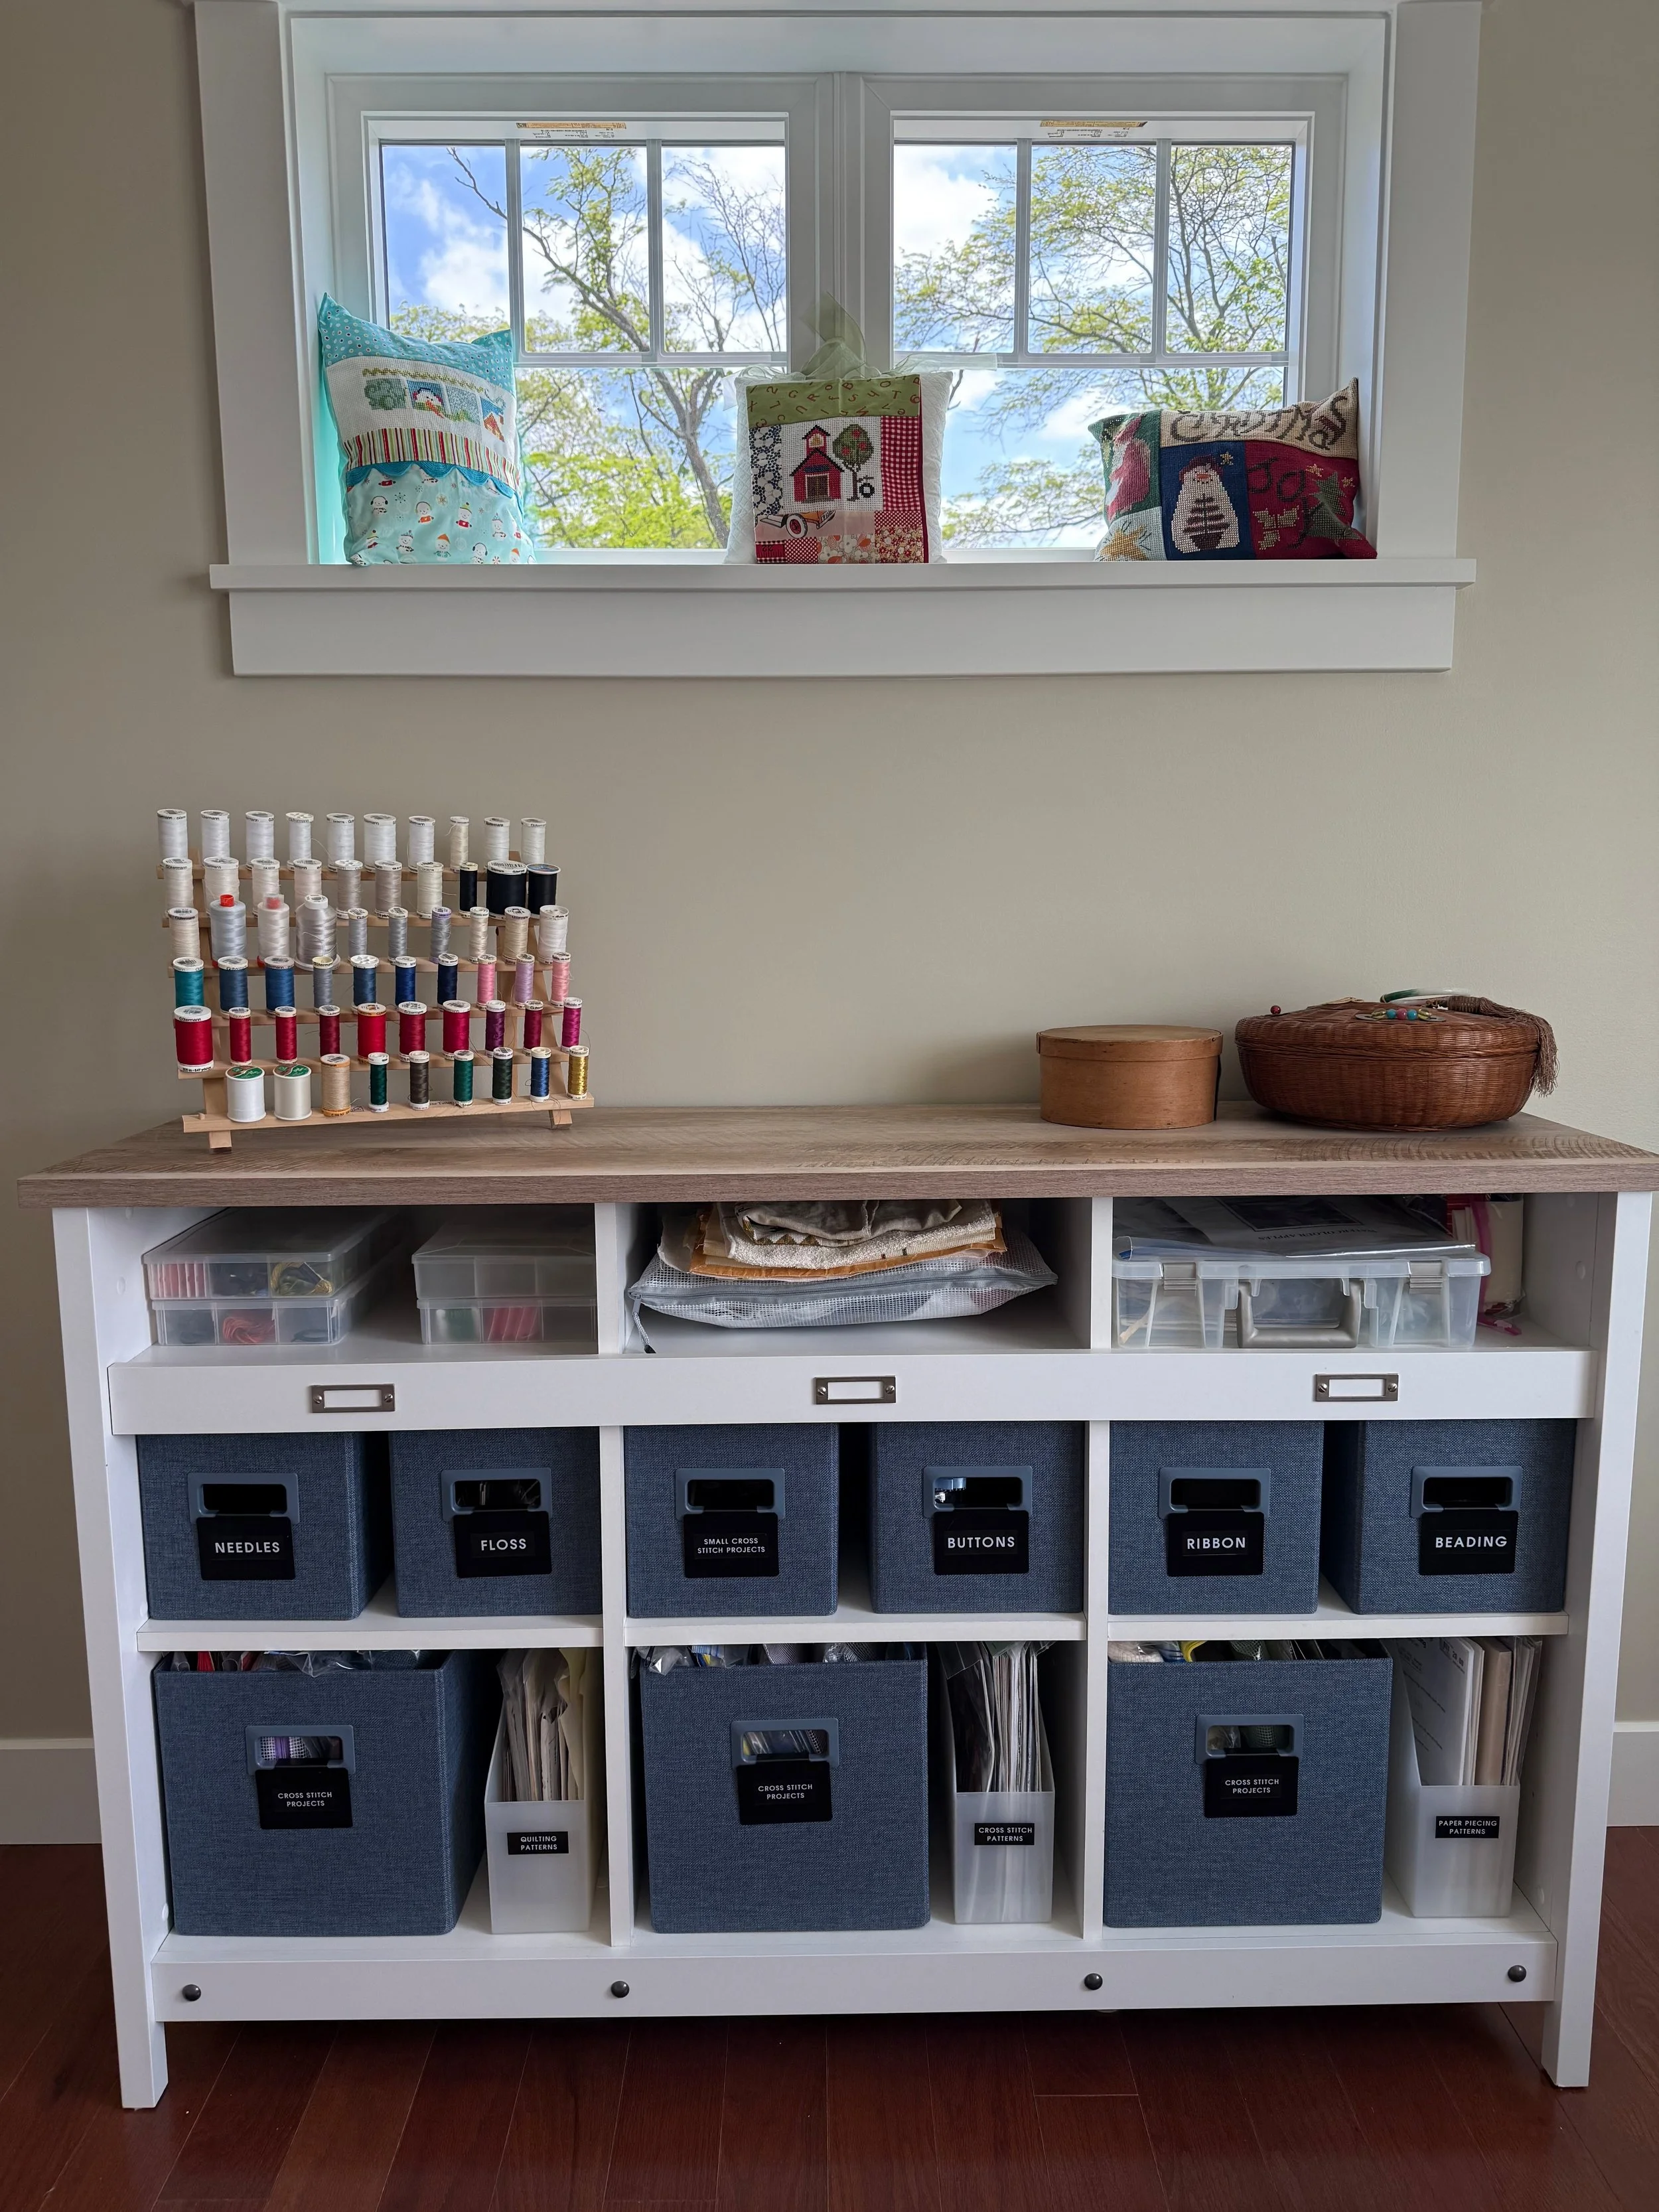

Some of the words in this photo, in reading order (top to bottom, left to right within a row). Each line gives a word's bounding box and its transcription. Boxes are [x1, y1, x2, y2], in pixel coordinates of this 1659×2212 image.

[214, 1541, 280, 1554] NEEDLES
[480, 1538, 526, 1552] FLOSS
[948, 1536, 1015, 1549] BUTTONS
[1187, 1537, 1246, 1550] RIBBON
[1435, 1536, 1507, 1548] BEADING
